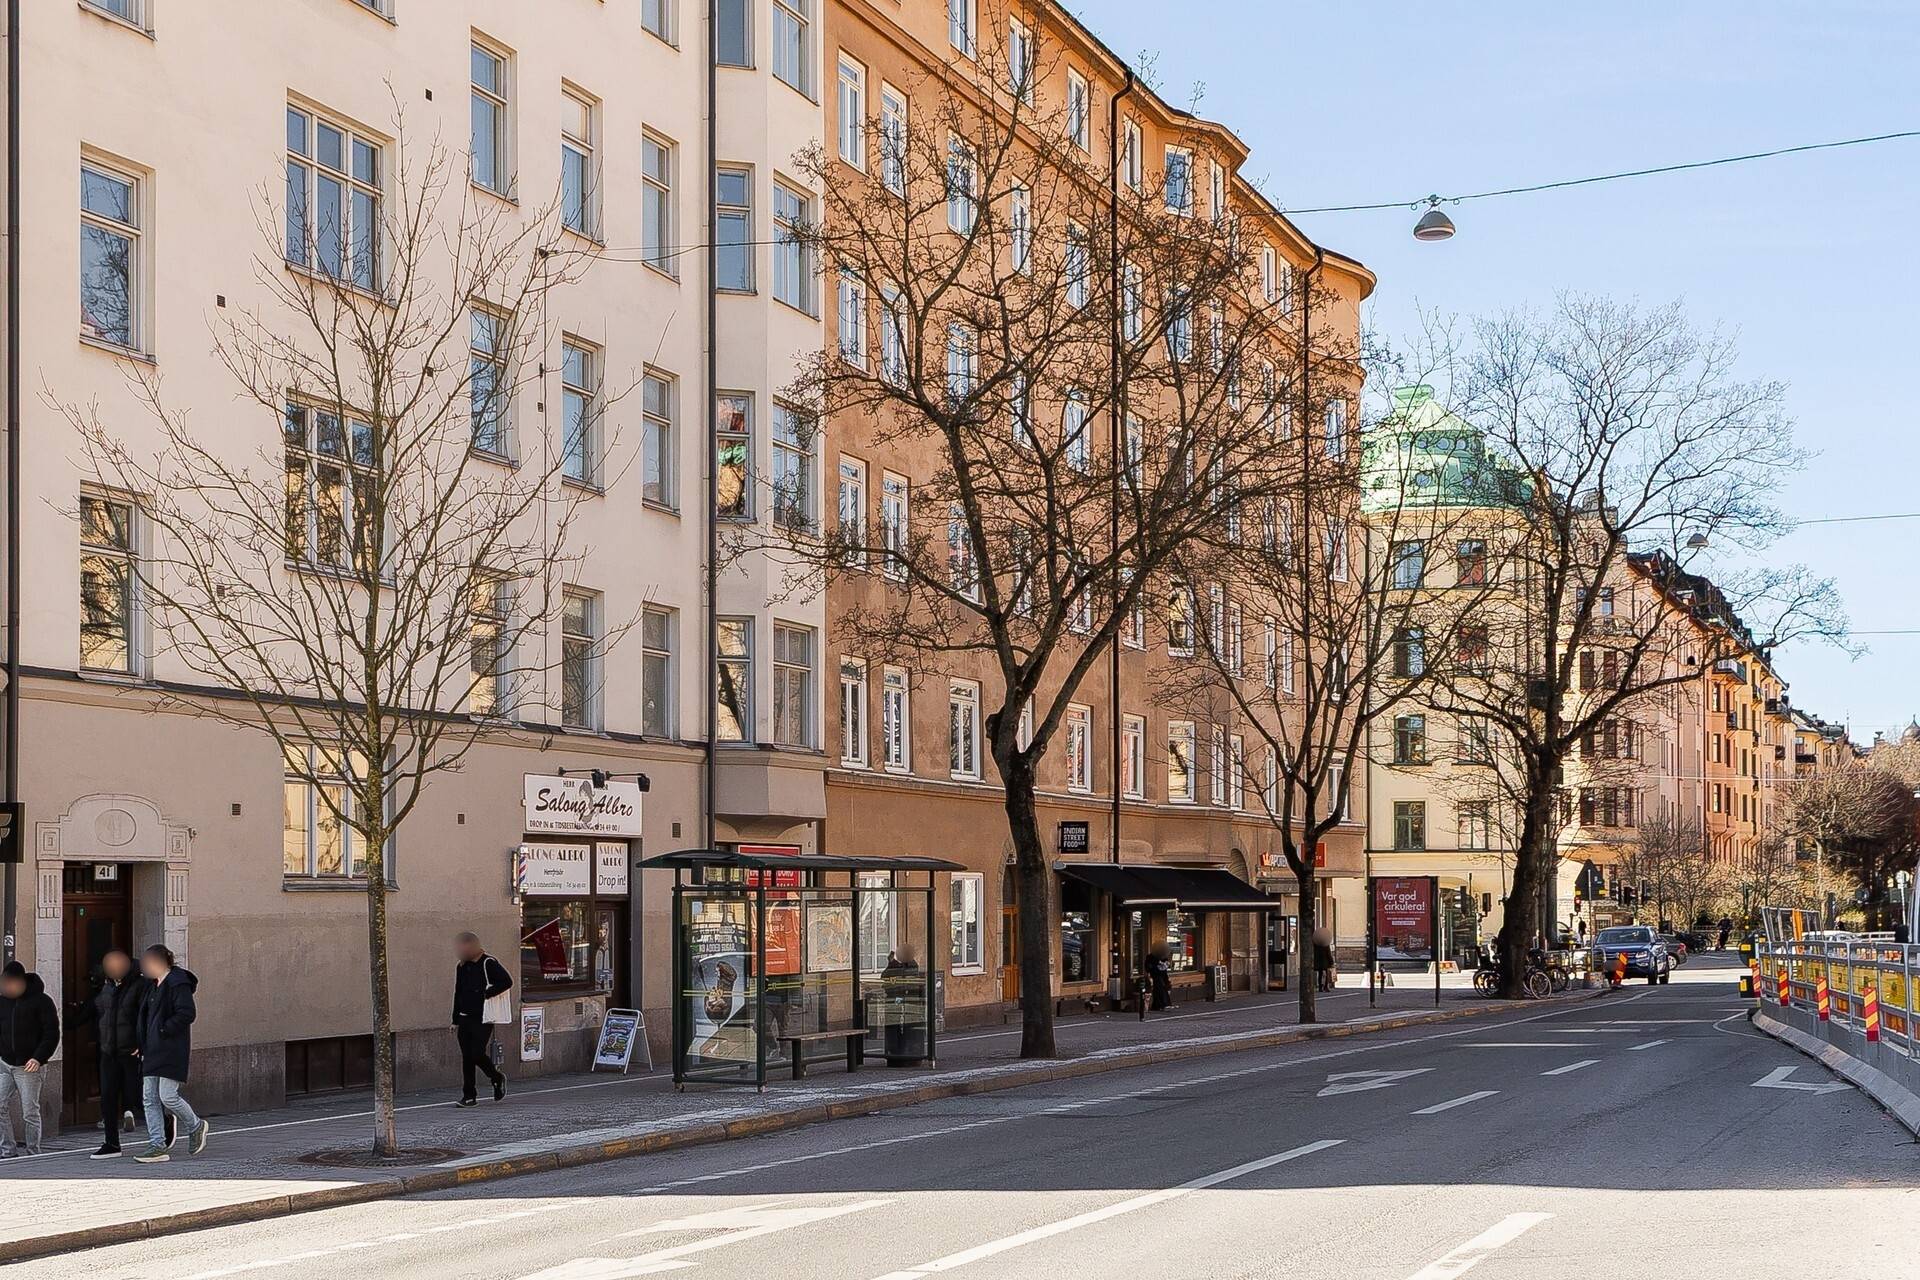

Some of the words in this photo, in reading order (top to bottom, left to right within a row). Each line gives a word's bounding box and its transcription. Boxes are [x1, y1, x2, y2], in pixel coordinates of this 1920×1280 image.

[536, 788, 586, 821] Salong
[588, 795, 633, 817] Albro
[529, 820, 542, 828] DROP
[527, 847, 555, 860] ALONG
[557, 849, 586, 861] ALBRO
[99, 867, 111, 878] 41
[599, 875, 616, 888] Drop
[617, 874, 626, 886] in!
[1381, 891, 1398, 901] Var
[1399, 890, 1417, 903] god
[1384, 901, 1425, 911] cirkulera!
